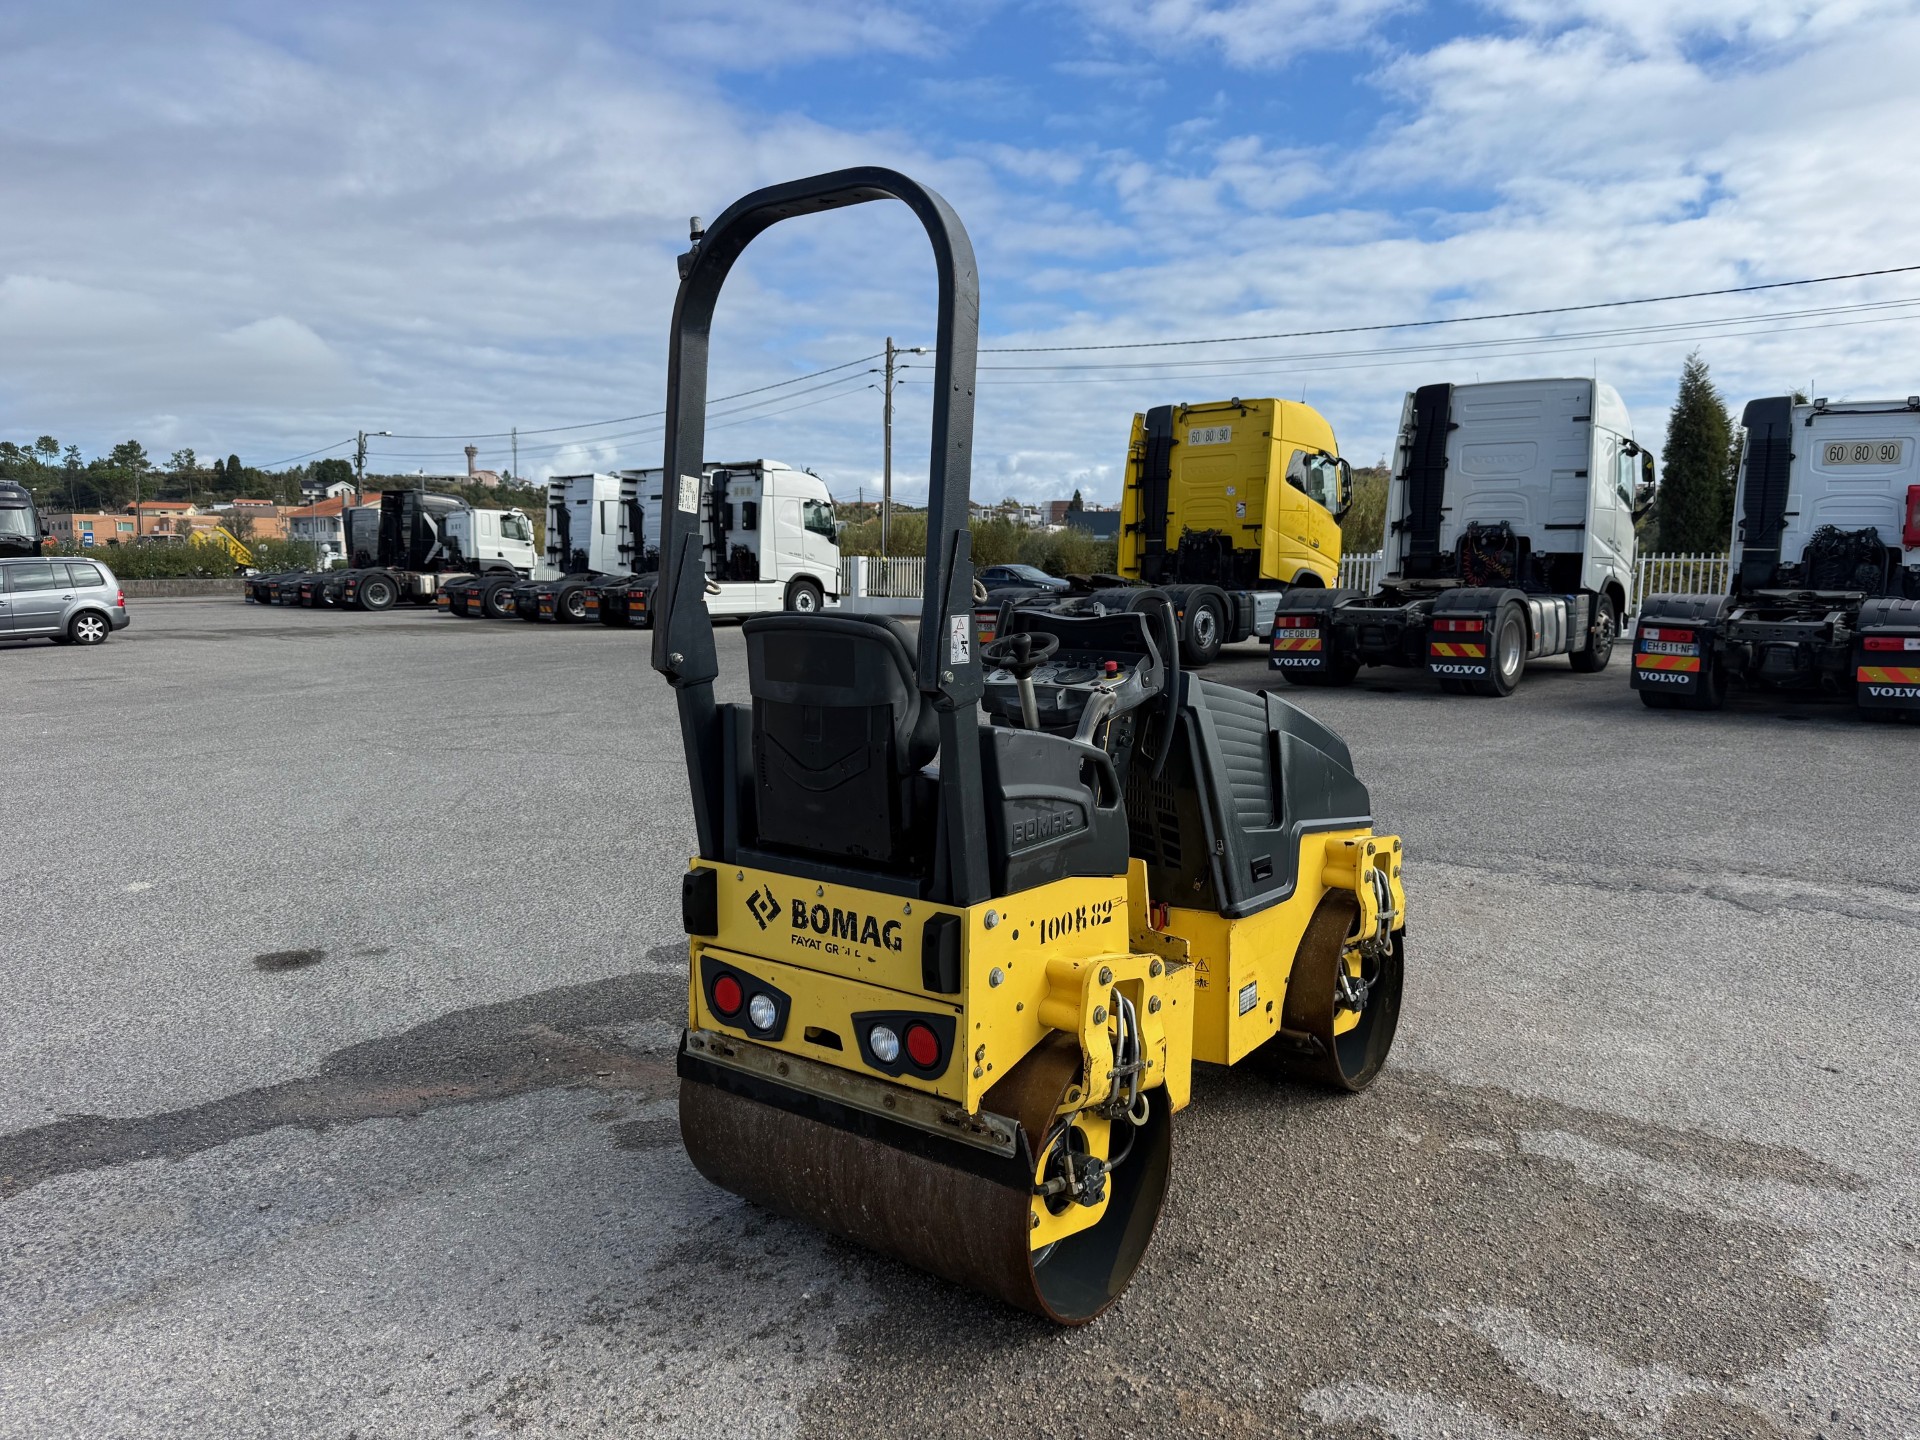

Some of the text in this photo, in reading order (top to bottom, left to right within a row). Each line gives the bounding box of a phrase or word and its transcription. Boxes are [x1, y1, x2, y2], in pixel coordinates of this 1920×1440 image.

[1191, 431, 1200, 443] 60
[1829, 445, 1895, 461] 60 80 90
[1273, 657, 1321, 667] VOLVO
[1430, 663, 1486, 675] VOLVO
[1638, 671, 1690, 684] VOLVO
[1867, 686, 1920, 698] VOLV
[791, 898, 903, 952] BOMAG
[791, 934, 822, 951] FAYAT
